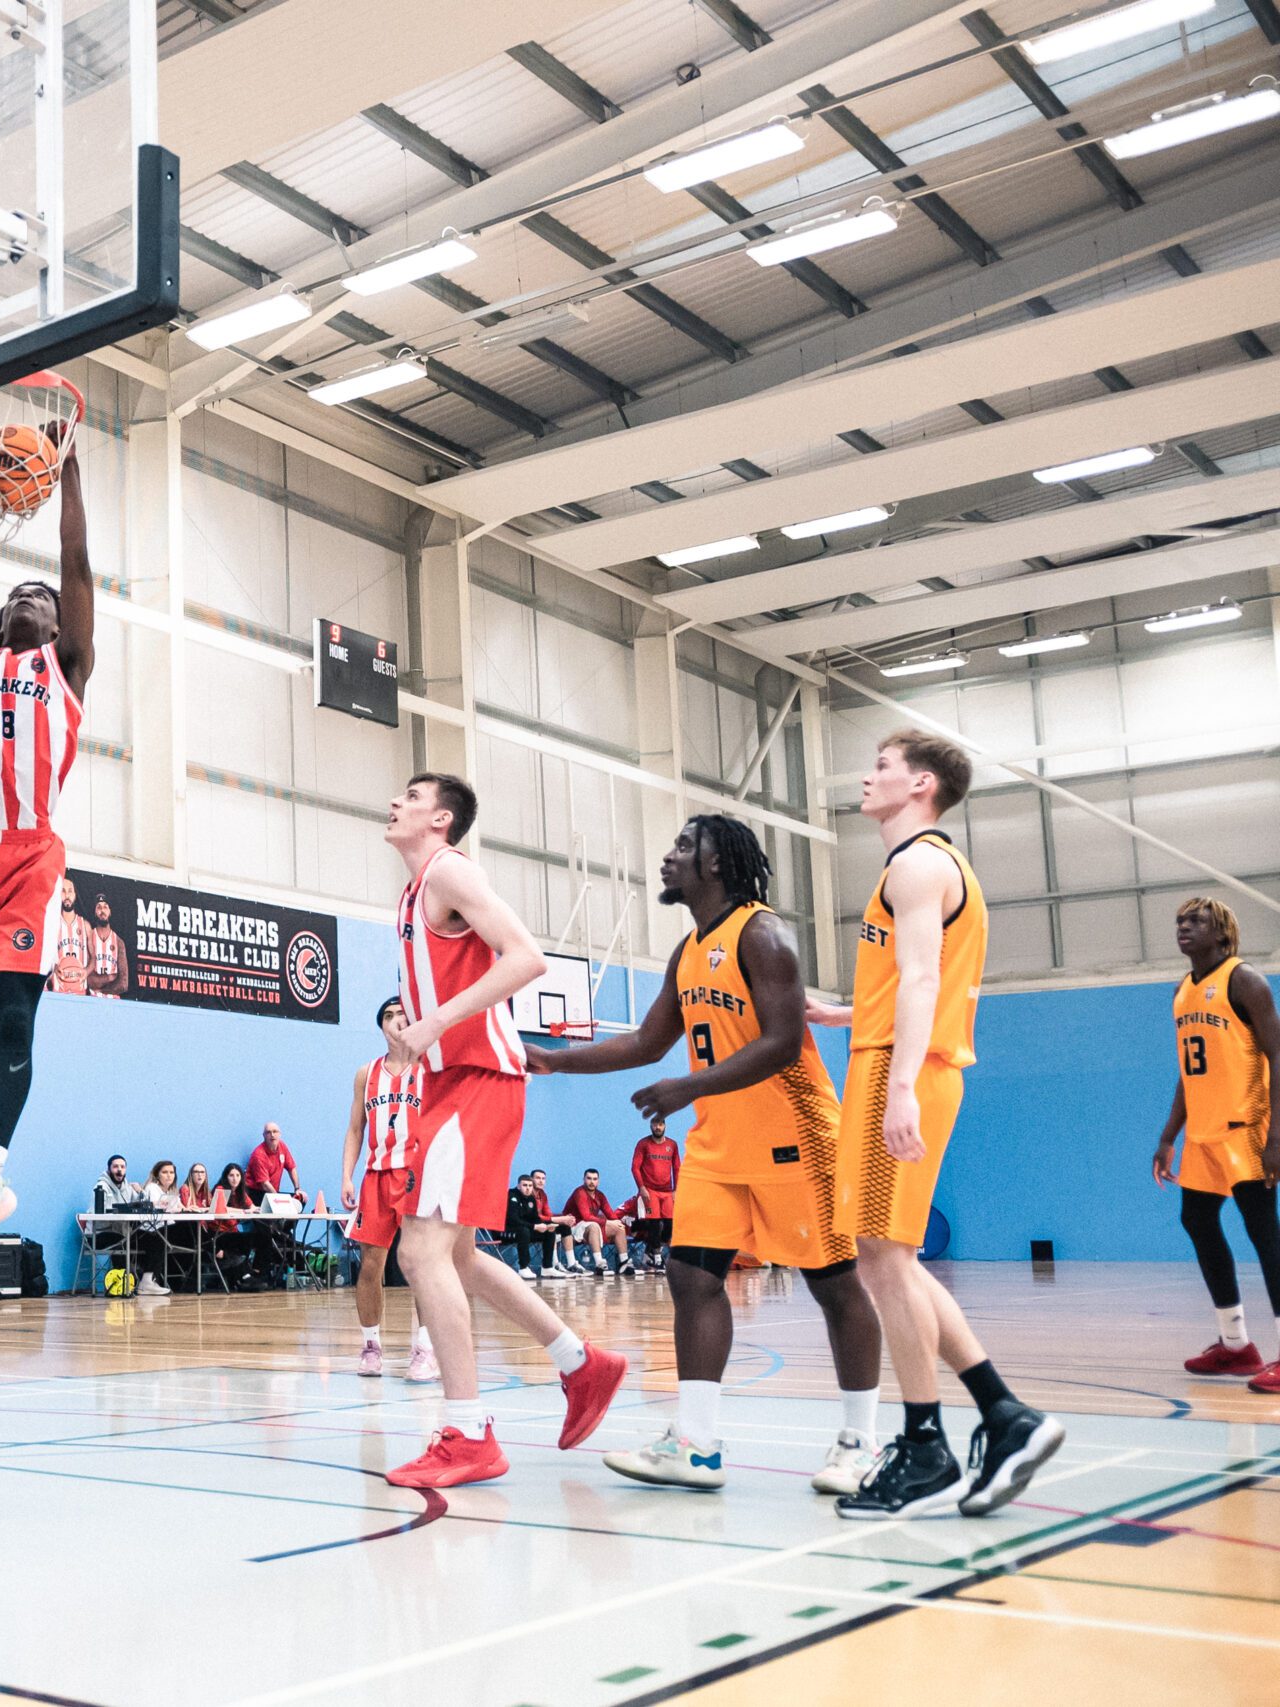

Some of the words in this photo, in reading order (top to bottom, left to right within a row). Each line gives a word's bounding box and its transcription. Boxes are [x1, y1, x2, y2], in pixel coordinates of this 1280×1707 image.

[330, 624, 341, 643] 9
[328, 643, 349, 663] HOME
[377, 640, 386, 659] 6
[372, 658, 397, 679] GUESTS
[2, 710, 15, 739] 8
[136, 898, 172, 931] MK
[178, 905, 279, 948] BREAKERS
[136, 930, 238, 964] BASKETBALL
[243, 947, 280, 970] CLUB
[691, 1023, 716, 1067] 9
[1183, 1035, 1208, 1076] 13
